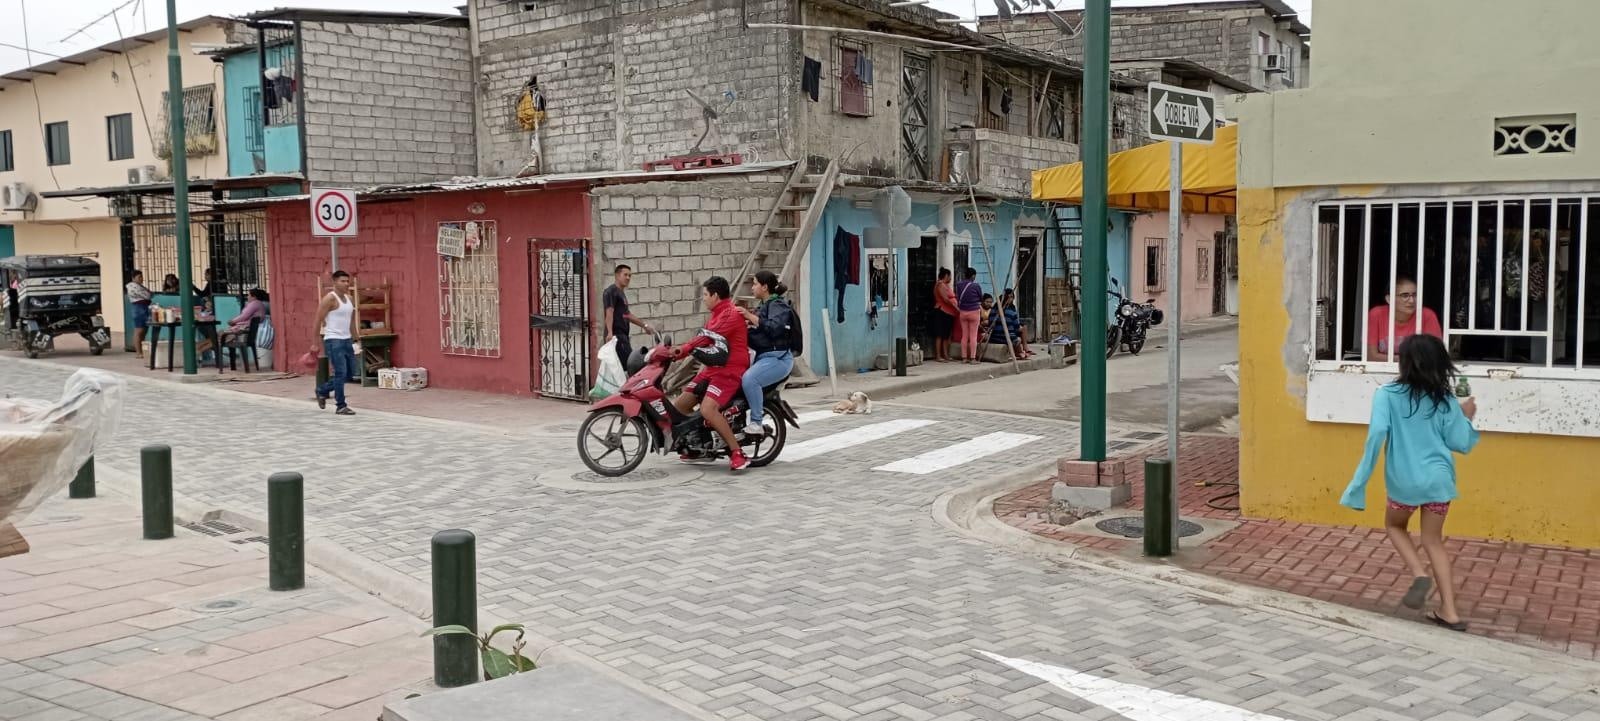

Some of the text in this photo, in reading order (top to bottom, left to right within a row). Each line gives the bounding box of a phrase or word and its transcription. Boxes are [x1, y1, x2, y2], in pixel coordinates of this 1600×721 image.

[1165, 103, 1199, 126] DOBLE VIA
[322, 203, 345, 221] 30
